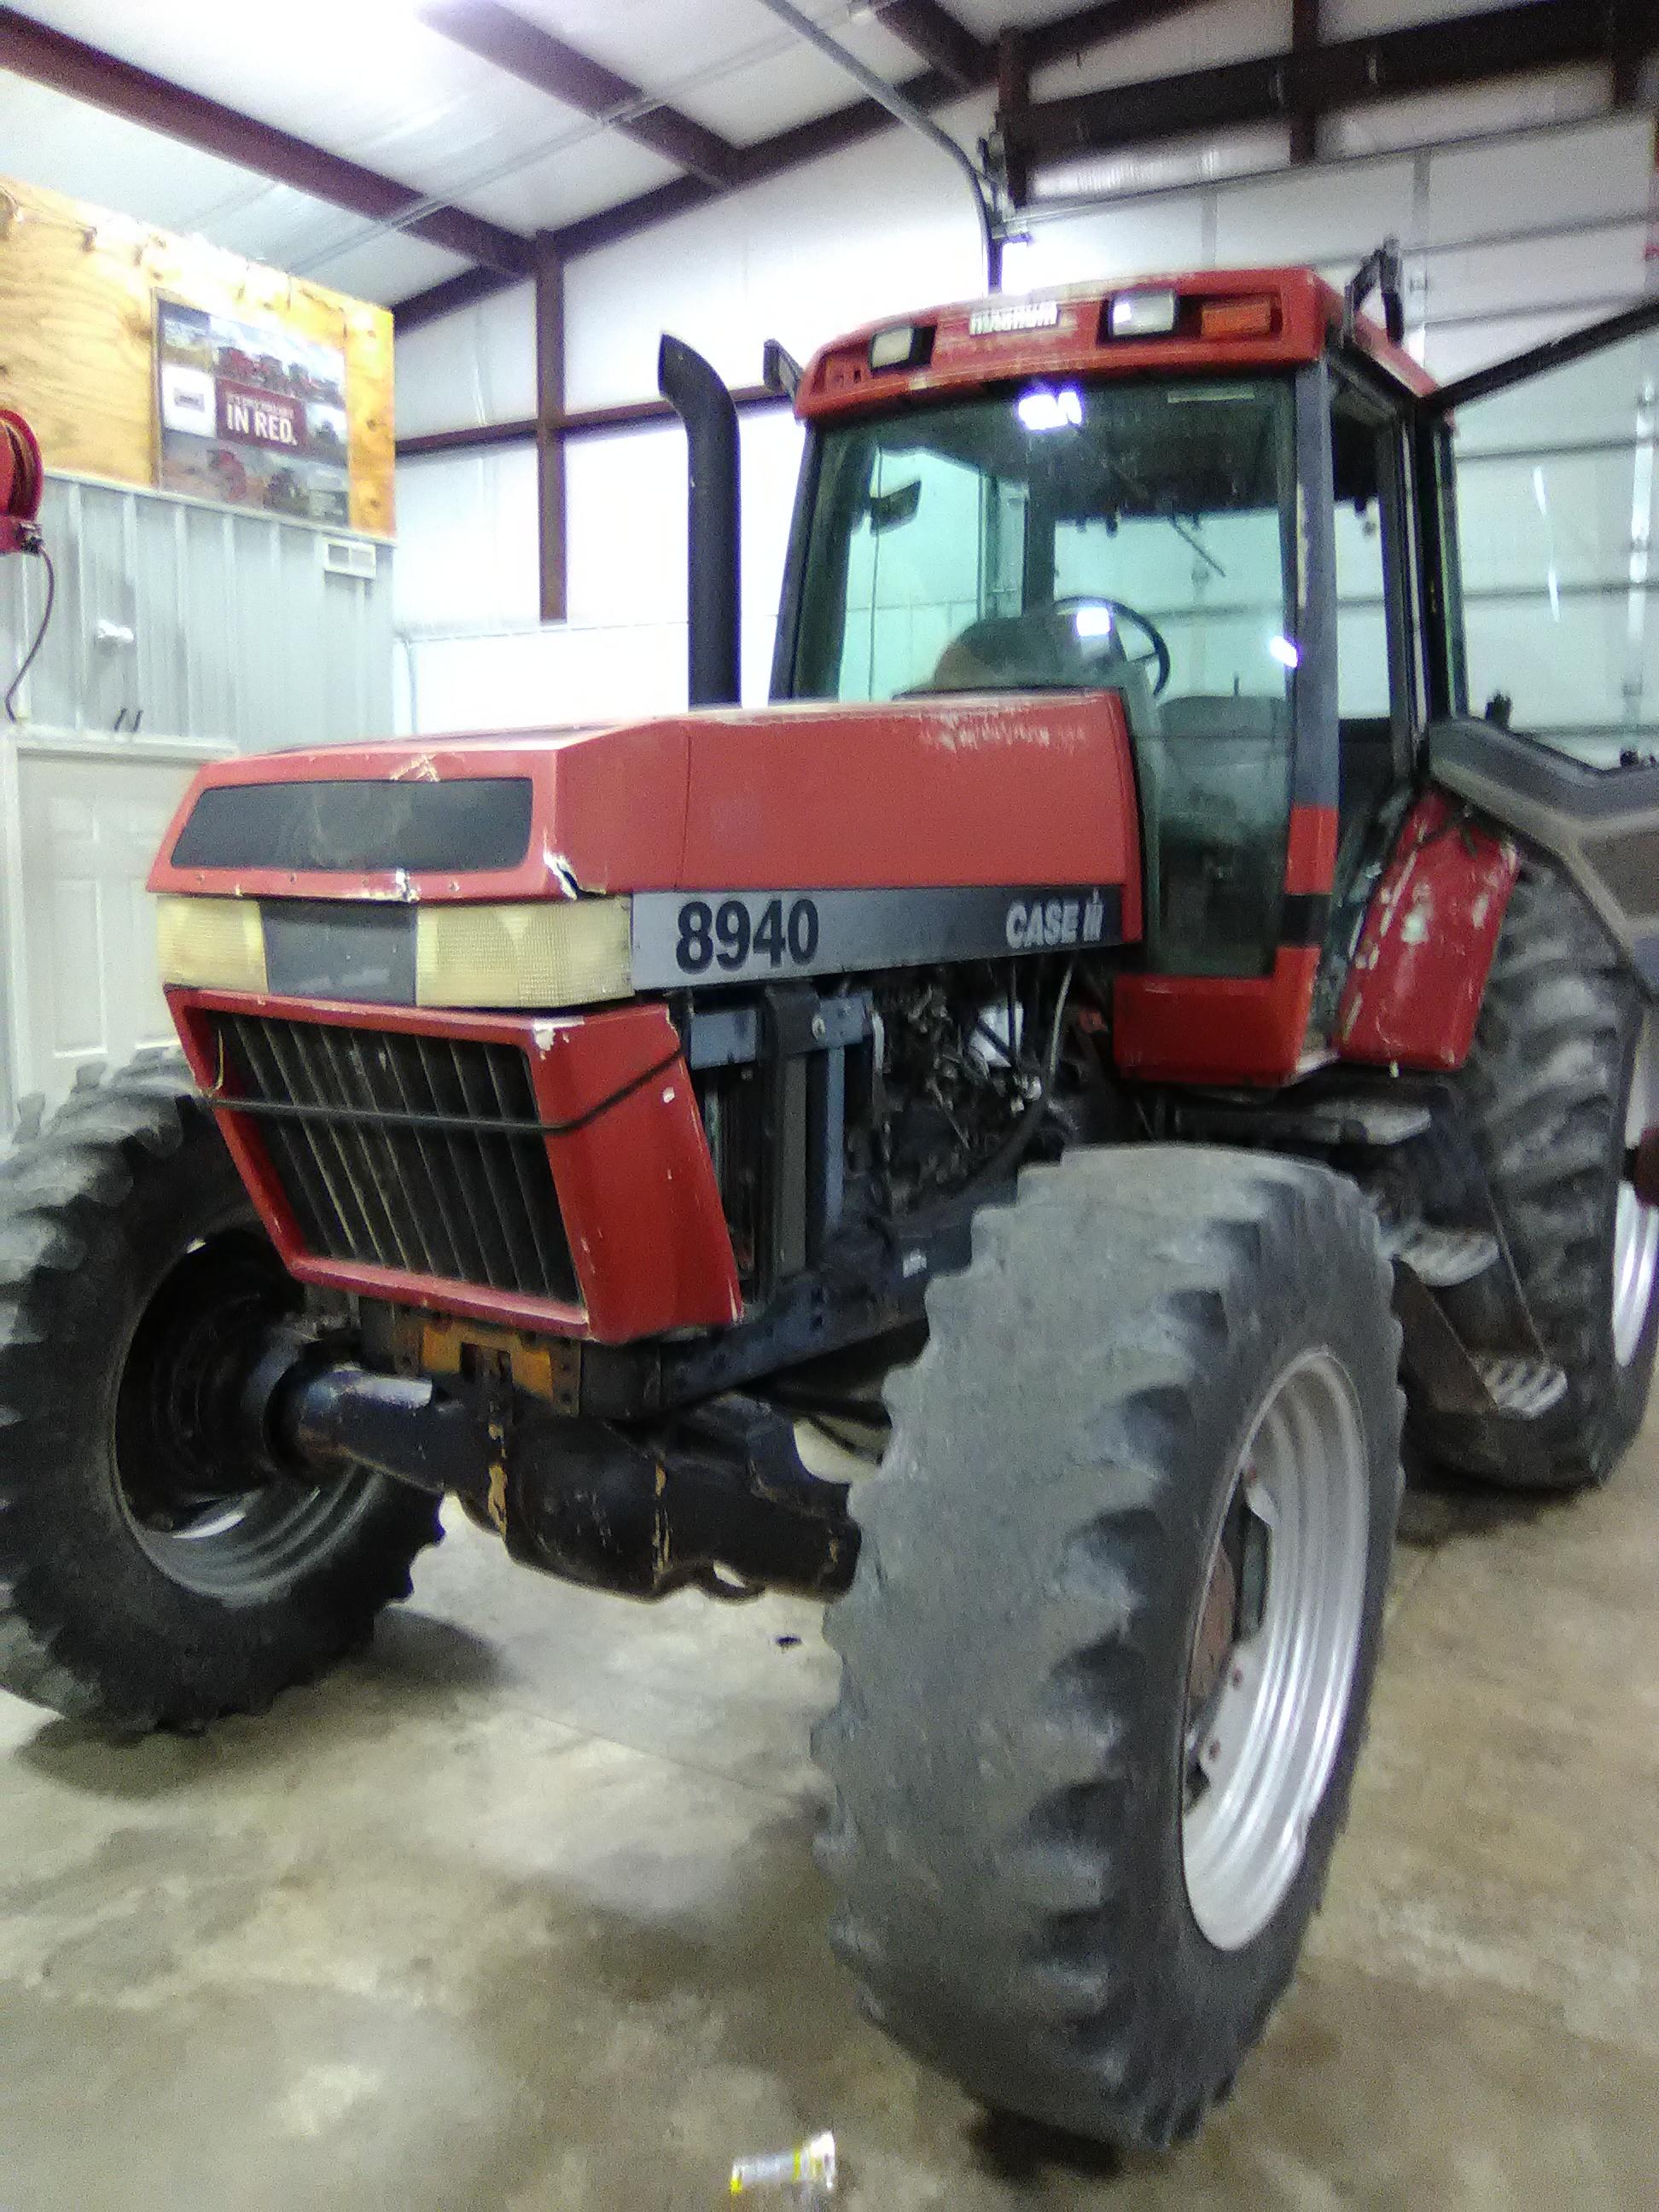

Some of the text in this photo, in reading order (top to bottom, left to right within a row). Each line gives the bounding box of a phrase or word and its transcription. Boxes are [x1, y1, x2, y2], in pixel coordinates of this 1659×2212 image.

[227, 403, 249, 434] IN
[254, 410, 298, 445] RED.
[675, 898, 819, 975] 8940
[1005, 900, 1079, 949] CASE
